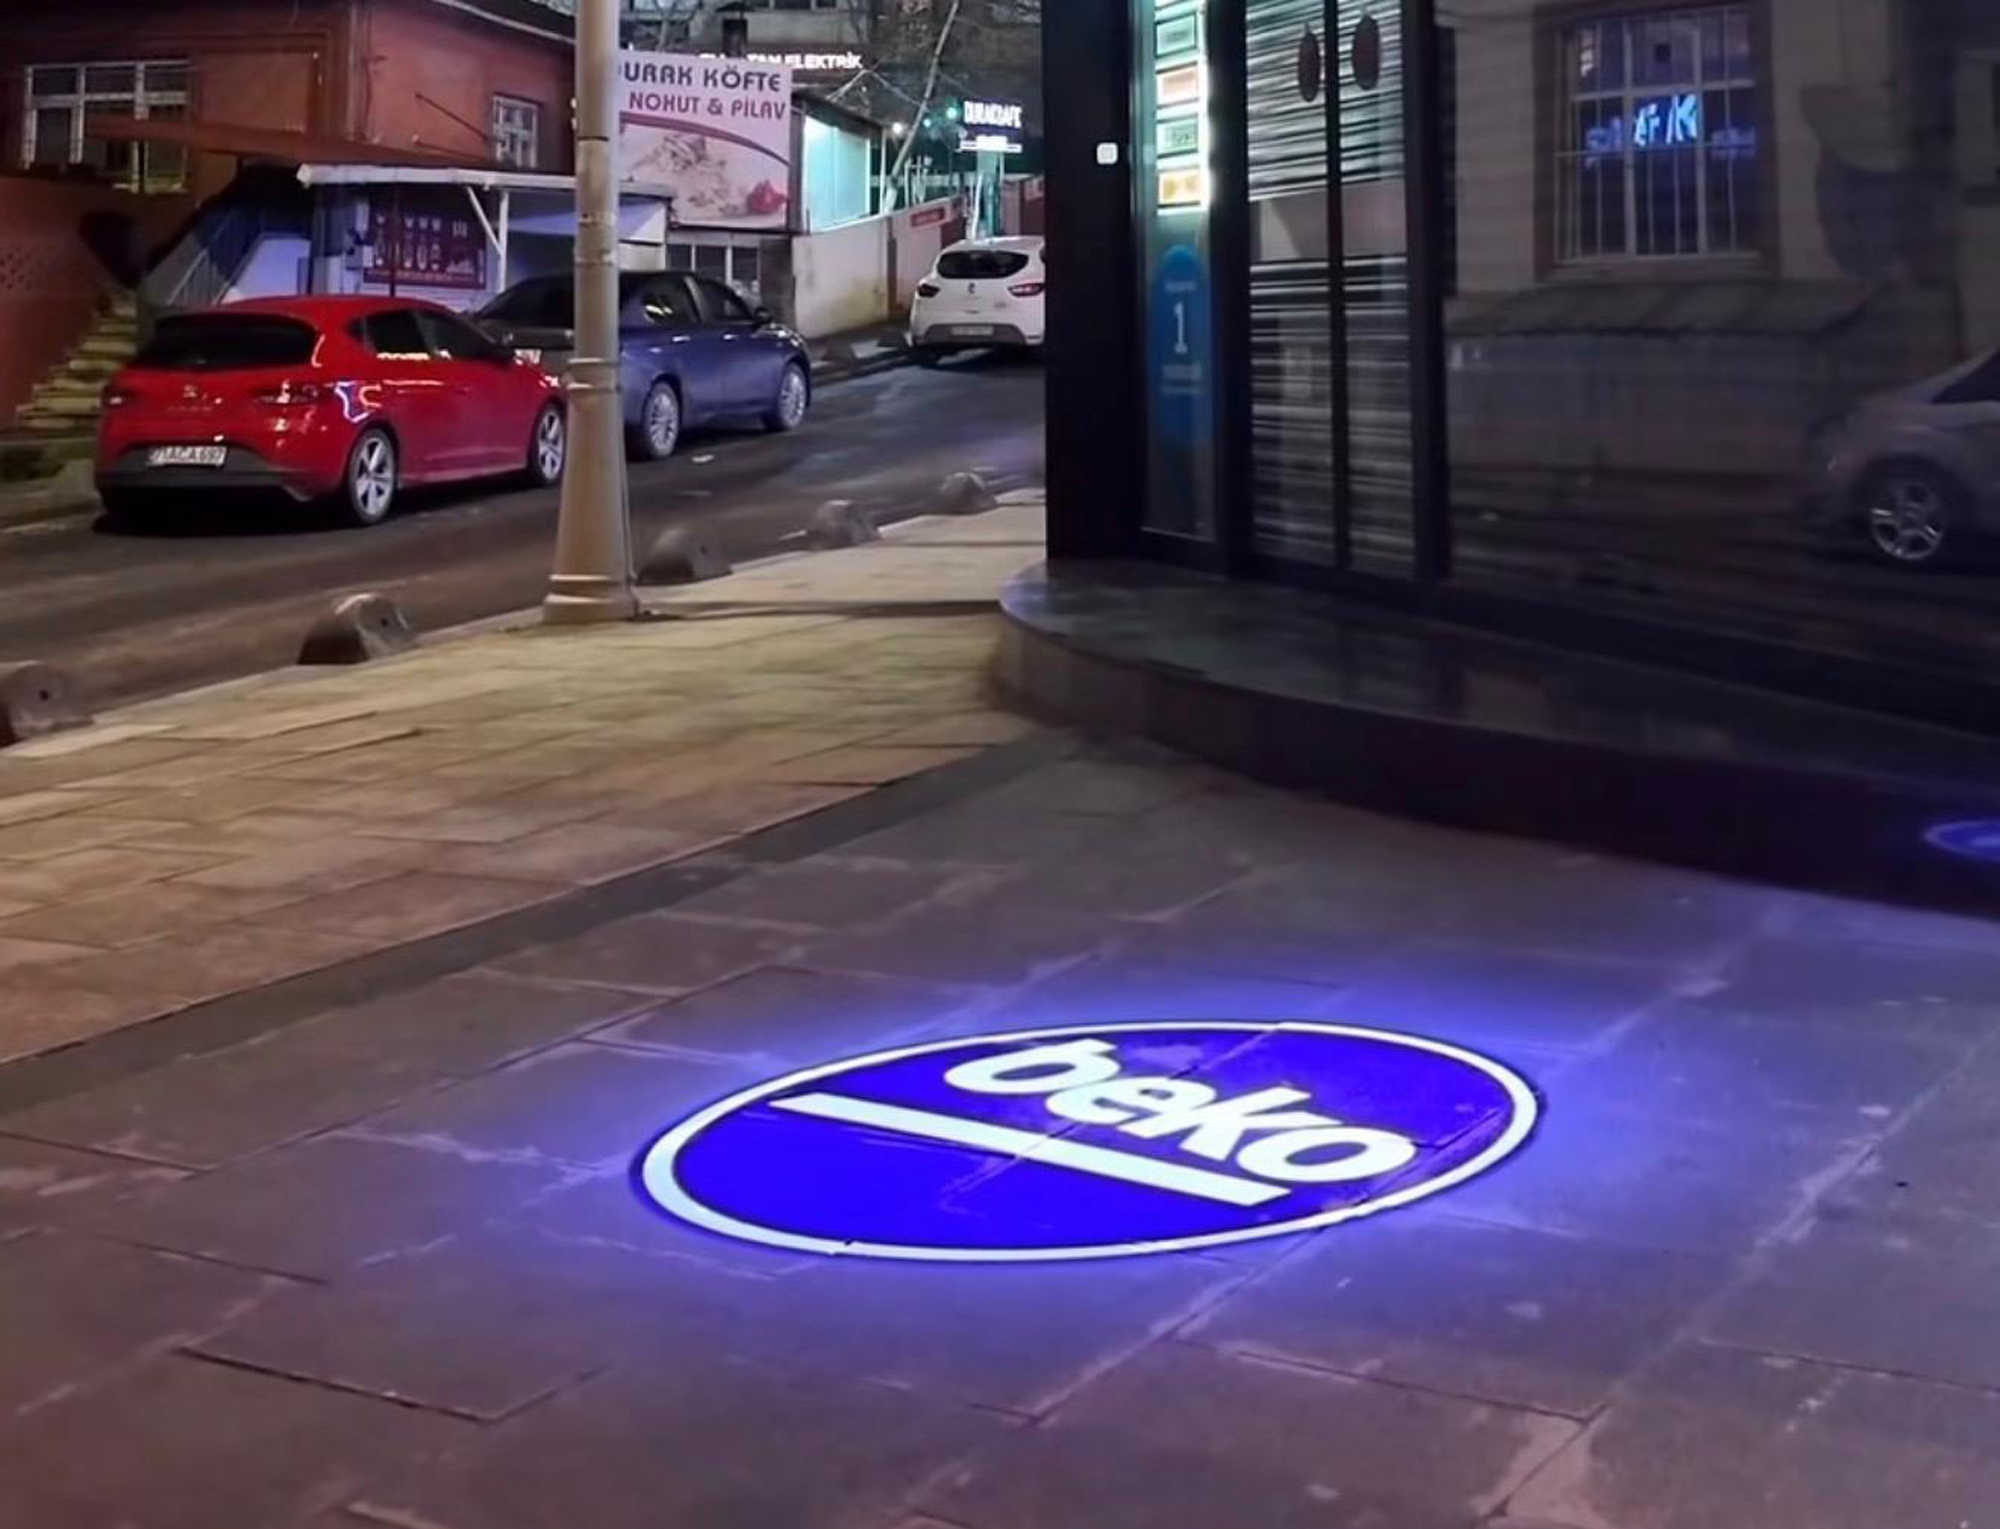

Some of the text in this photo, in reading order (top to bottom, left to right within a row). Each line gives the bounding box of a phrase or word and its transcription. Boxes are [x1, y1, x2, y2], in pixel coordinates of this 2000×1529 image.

[618, 60, 781, 92] URAK KÖFTE
[629, 92, 786, 119] NOHUT & PİLAV
[943, 1037, 1417, 1183] beko
